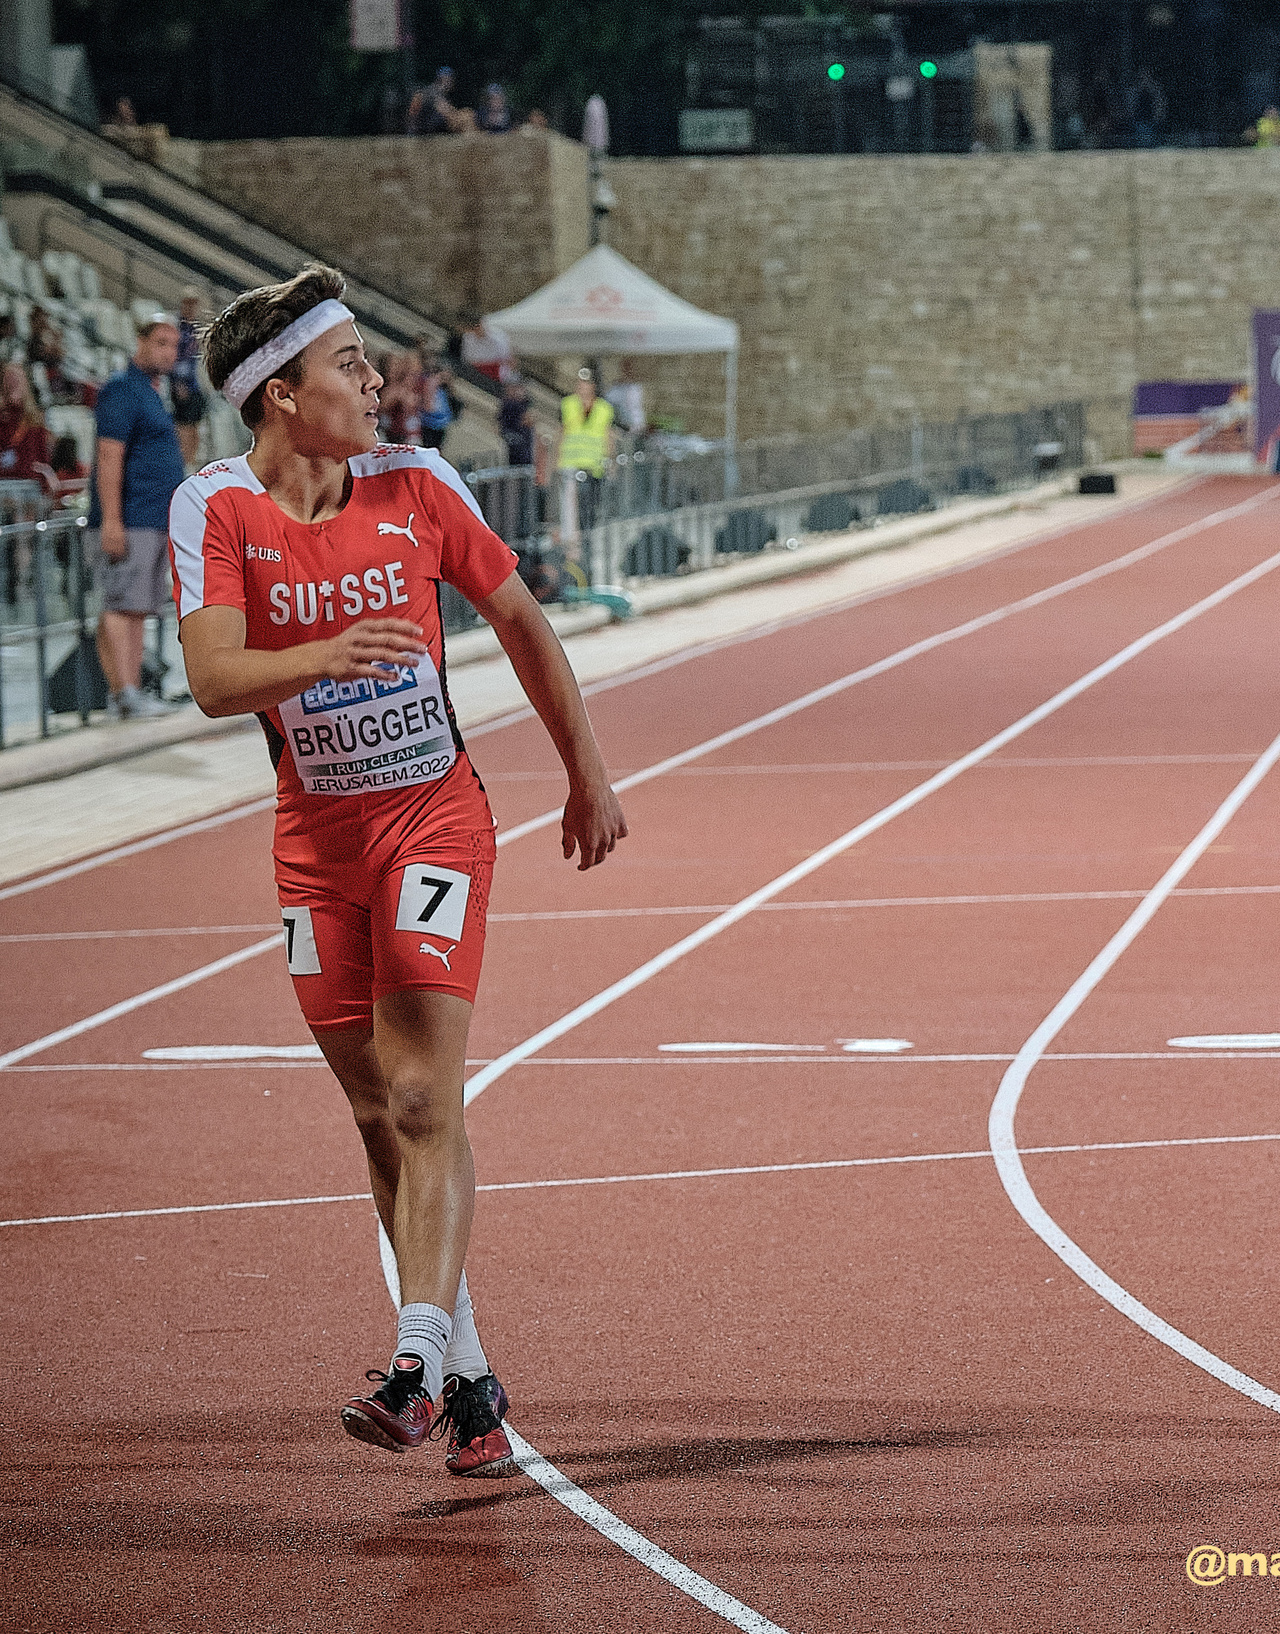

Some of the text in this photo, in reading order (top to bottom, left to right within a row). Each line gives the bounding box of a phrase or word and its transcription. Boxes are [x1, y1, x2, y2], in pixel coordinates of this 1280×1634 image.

[258, 547, 281, 562] UBS
[292, 695, 445, 757] BRÜGGER
[311, 755, 450, 792] JERUSALEM 2022
[328, 765, 334, 776] I
[337, 762, 368, 773] RUN
[415, 875, 454, 924] 7
